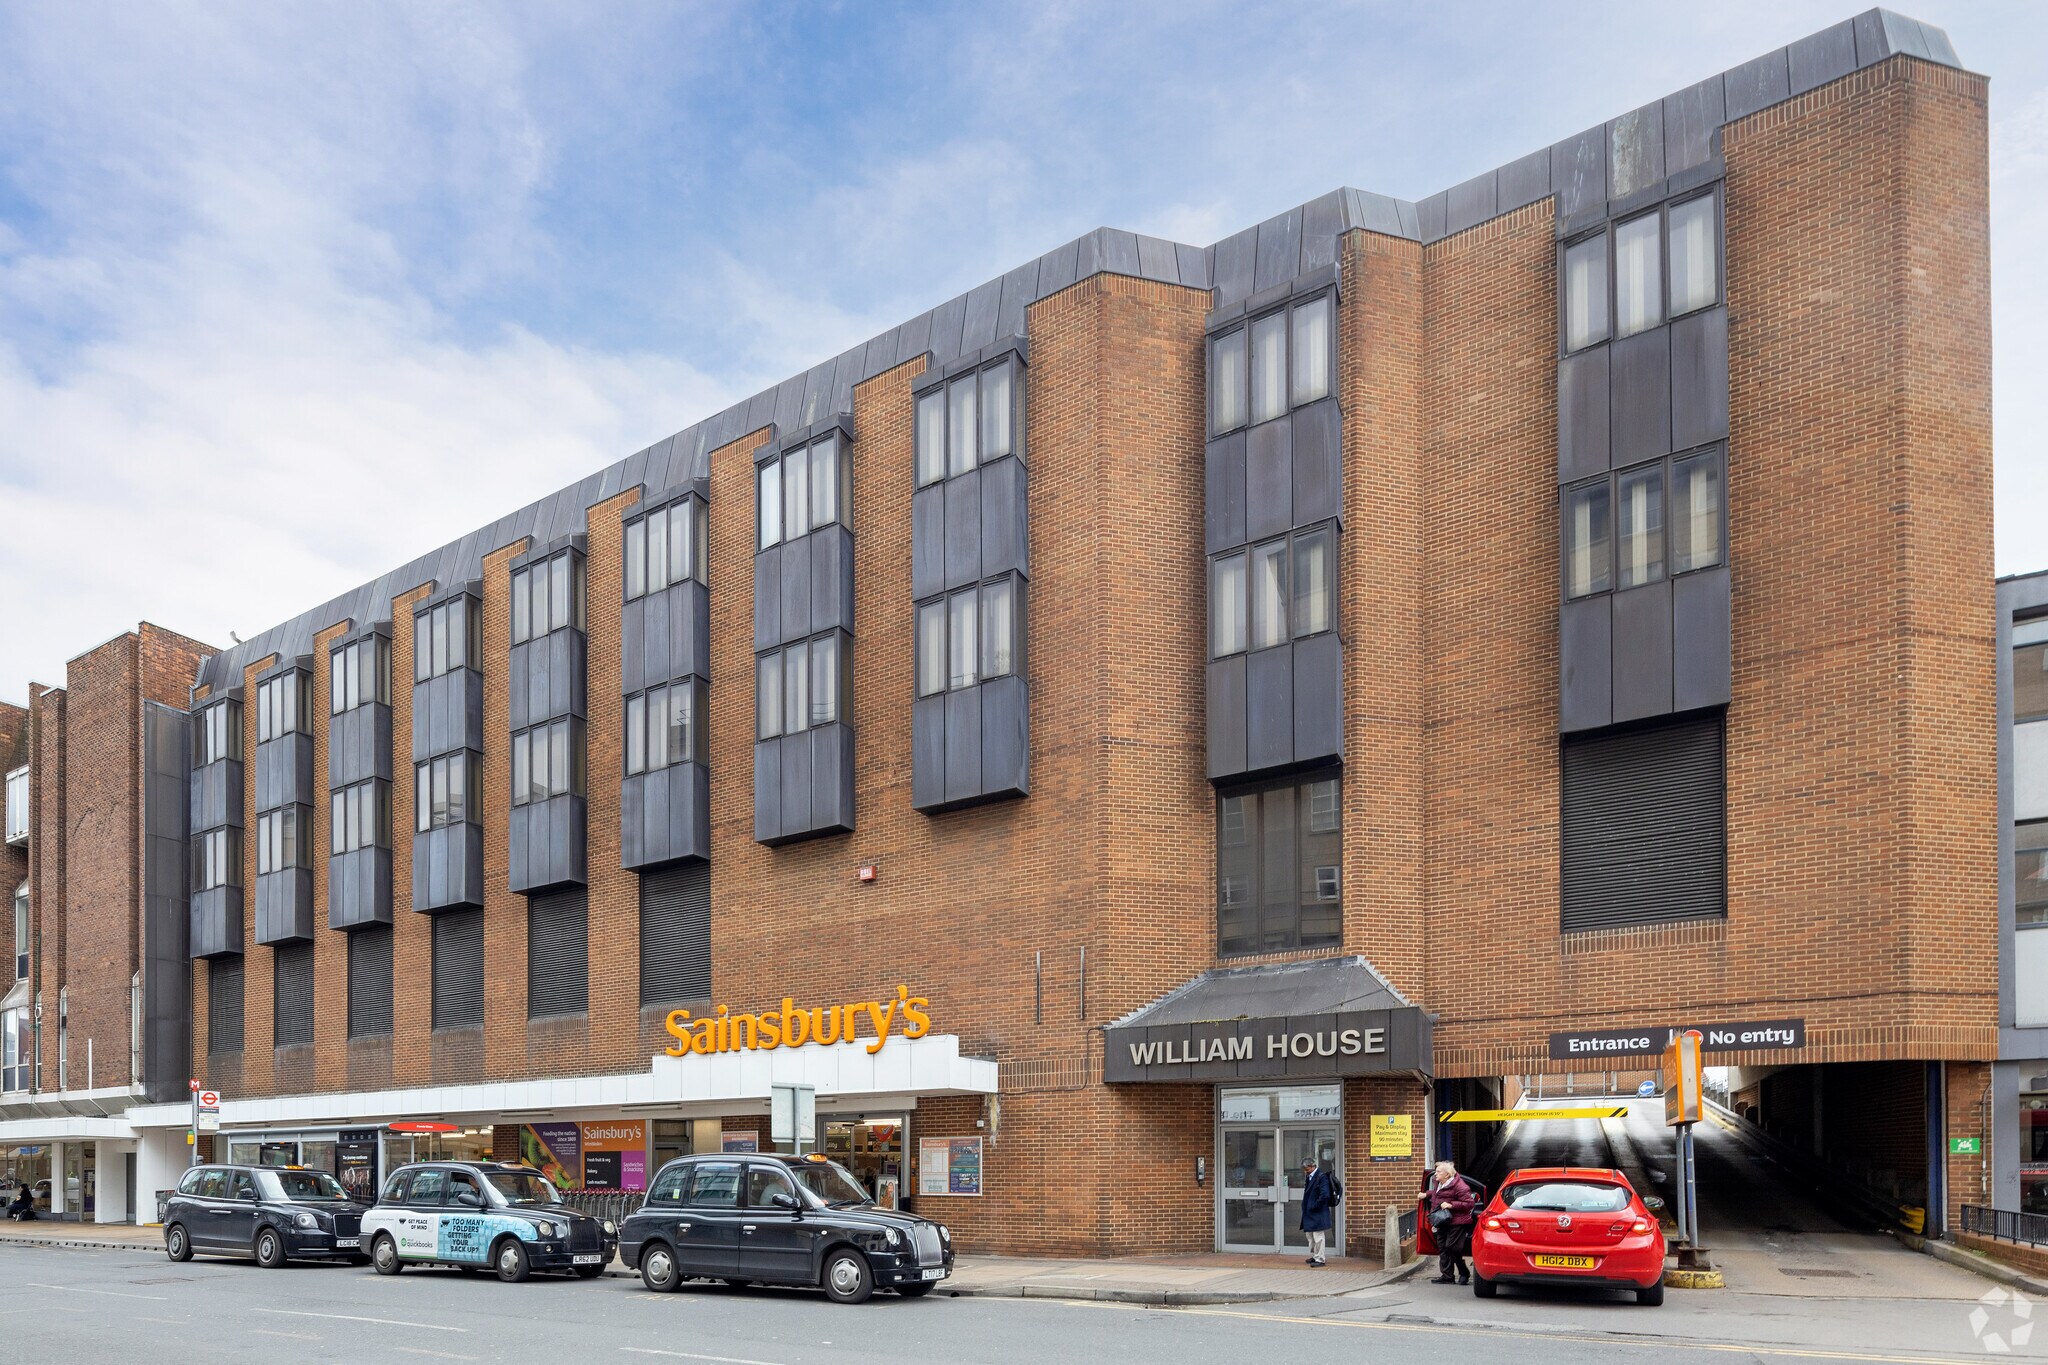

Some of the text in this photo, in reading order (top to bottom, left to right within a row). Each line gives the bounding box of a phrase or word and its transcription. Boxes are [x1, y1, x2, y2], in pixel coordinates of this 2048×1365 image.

[665, 985, 930, 1057] Sainsbury's
[1569, 1036, 1650, 1052] Entrance
[1709, 1028, 1795, 1045] No entry
[1129, 1028, 1385, 1065] WILLIAM HOUSE
[191, 1080, 200, 1088] M
[584, 1126, 641, 1141] Sainsbury's
[1542, 1256, 1588, 1266] HG12 DBX
